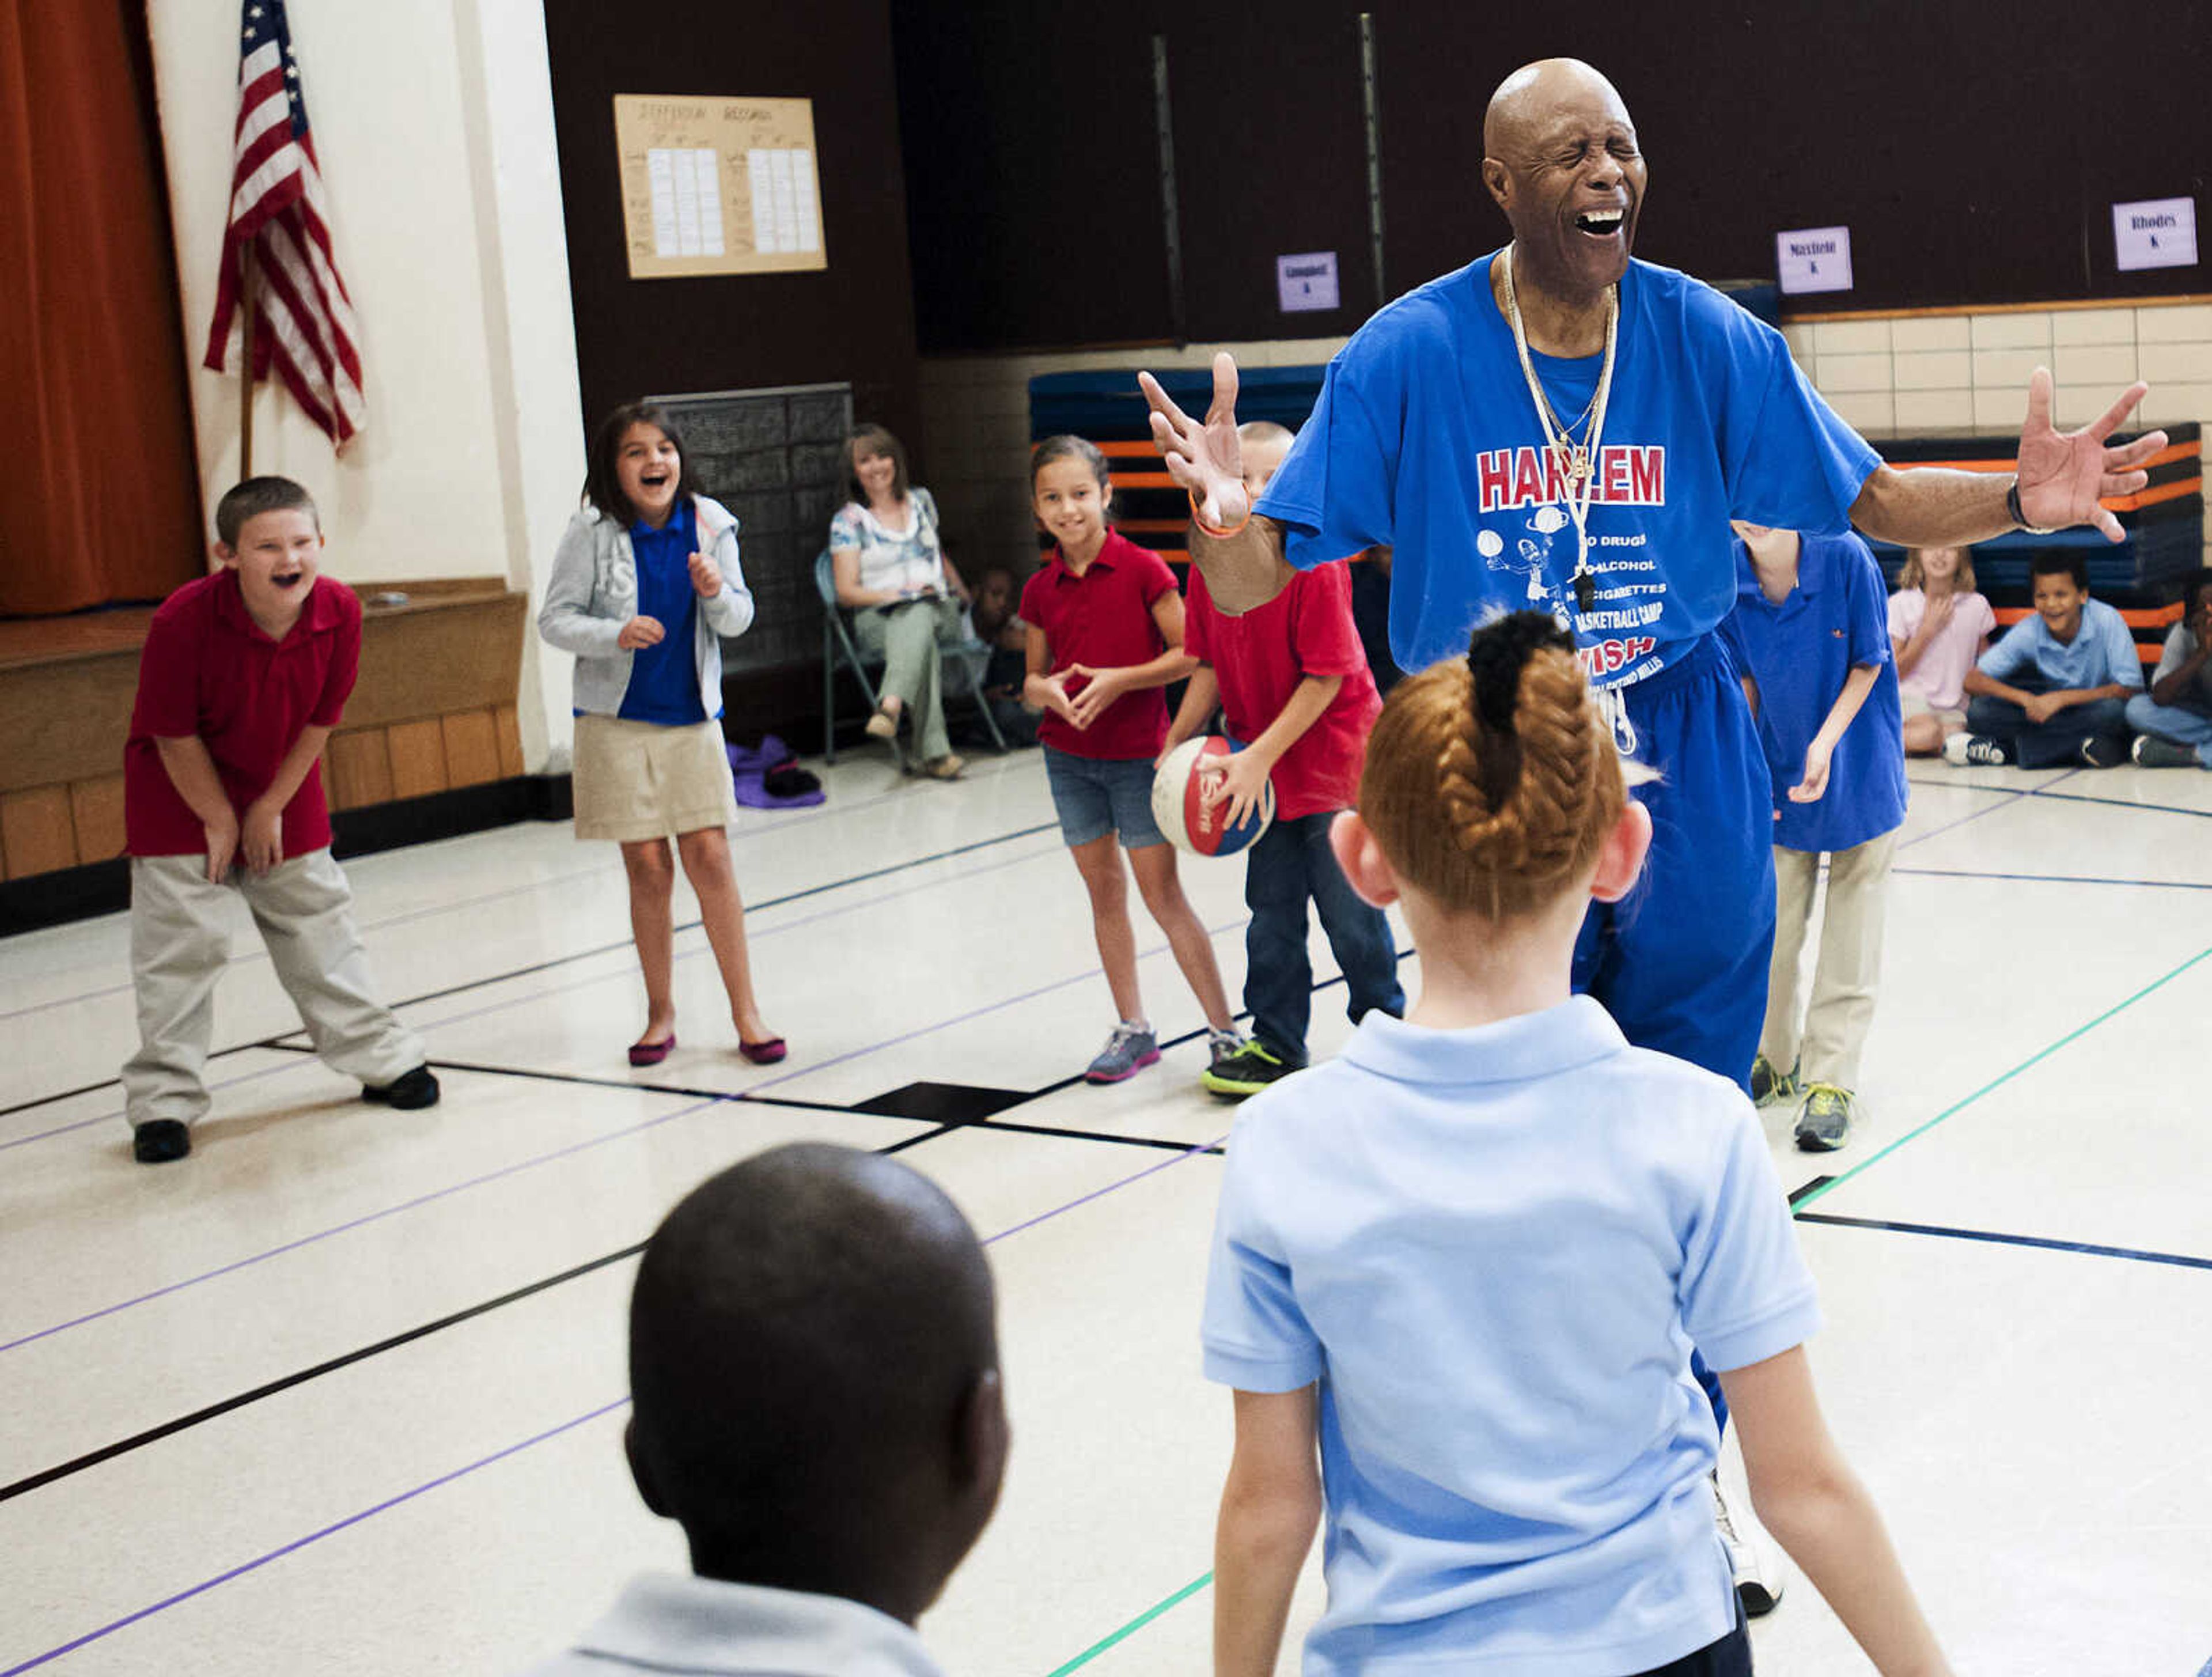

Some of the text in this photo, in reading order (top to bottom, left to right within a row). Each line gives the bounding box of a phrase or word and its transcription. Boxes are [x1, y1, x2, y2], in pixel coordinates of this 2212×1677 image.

[2131, 214, 2177, 230] Rhodes
[1476, 446, 1665, 513] HARLEM
[1601, 532, 1646, 547] DRUGS
